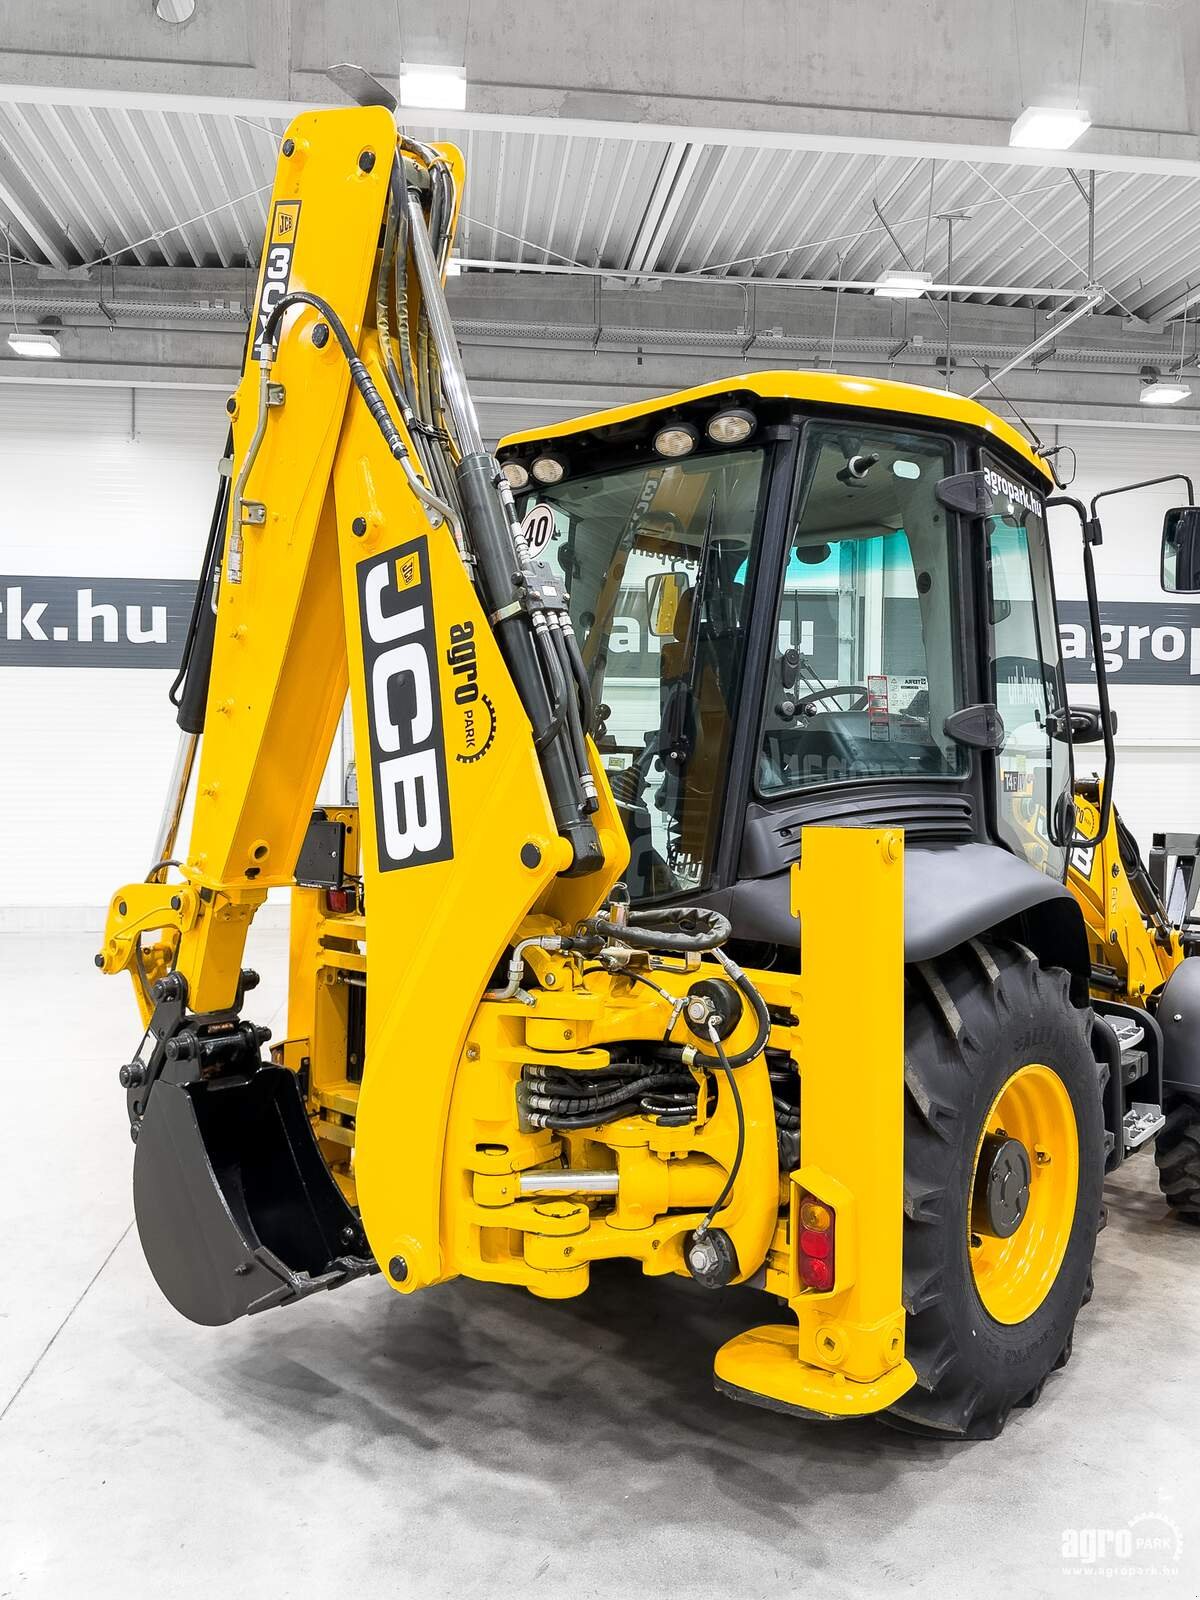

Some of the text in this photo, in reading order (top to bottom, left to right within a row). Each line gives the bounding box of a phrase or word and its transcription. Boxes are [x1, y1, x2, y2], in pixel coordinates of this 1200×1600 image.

[279, 214, 293, 234] JCB
[984, 467, 1042, 518] agropark.hu
[525, 516, 549, 547] 40
[402, 562, 414, 584] JCB
[0, 587, 168, 644] k.hu
[447, 621, 479, 705] agro
[366, 561, 442, 861] JCB
[464, 709, 476, 748] PARK
